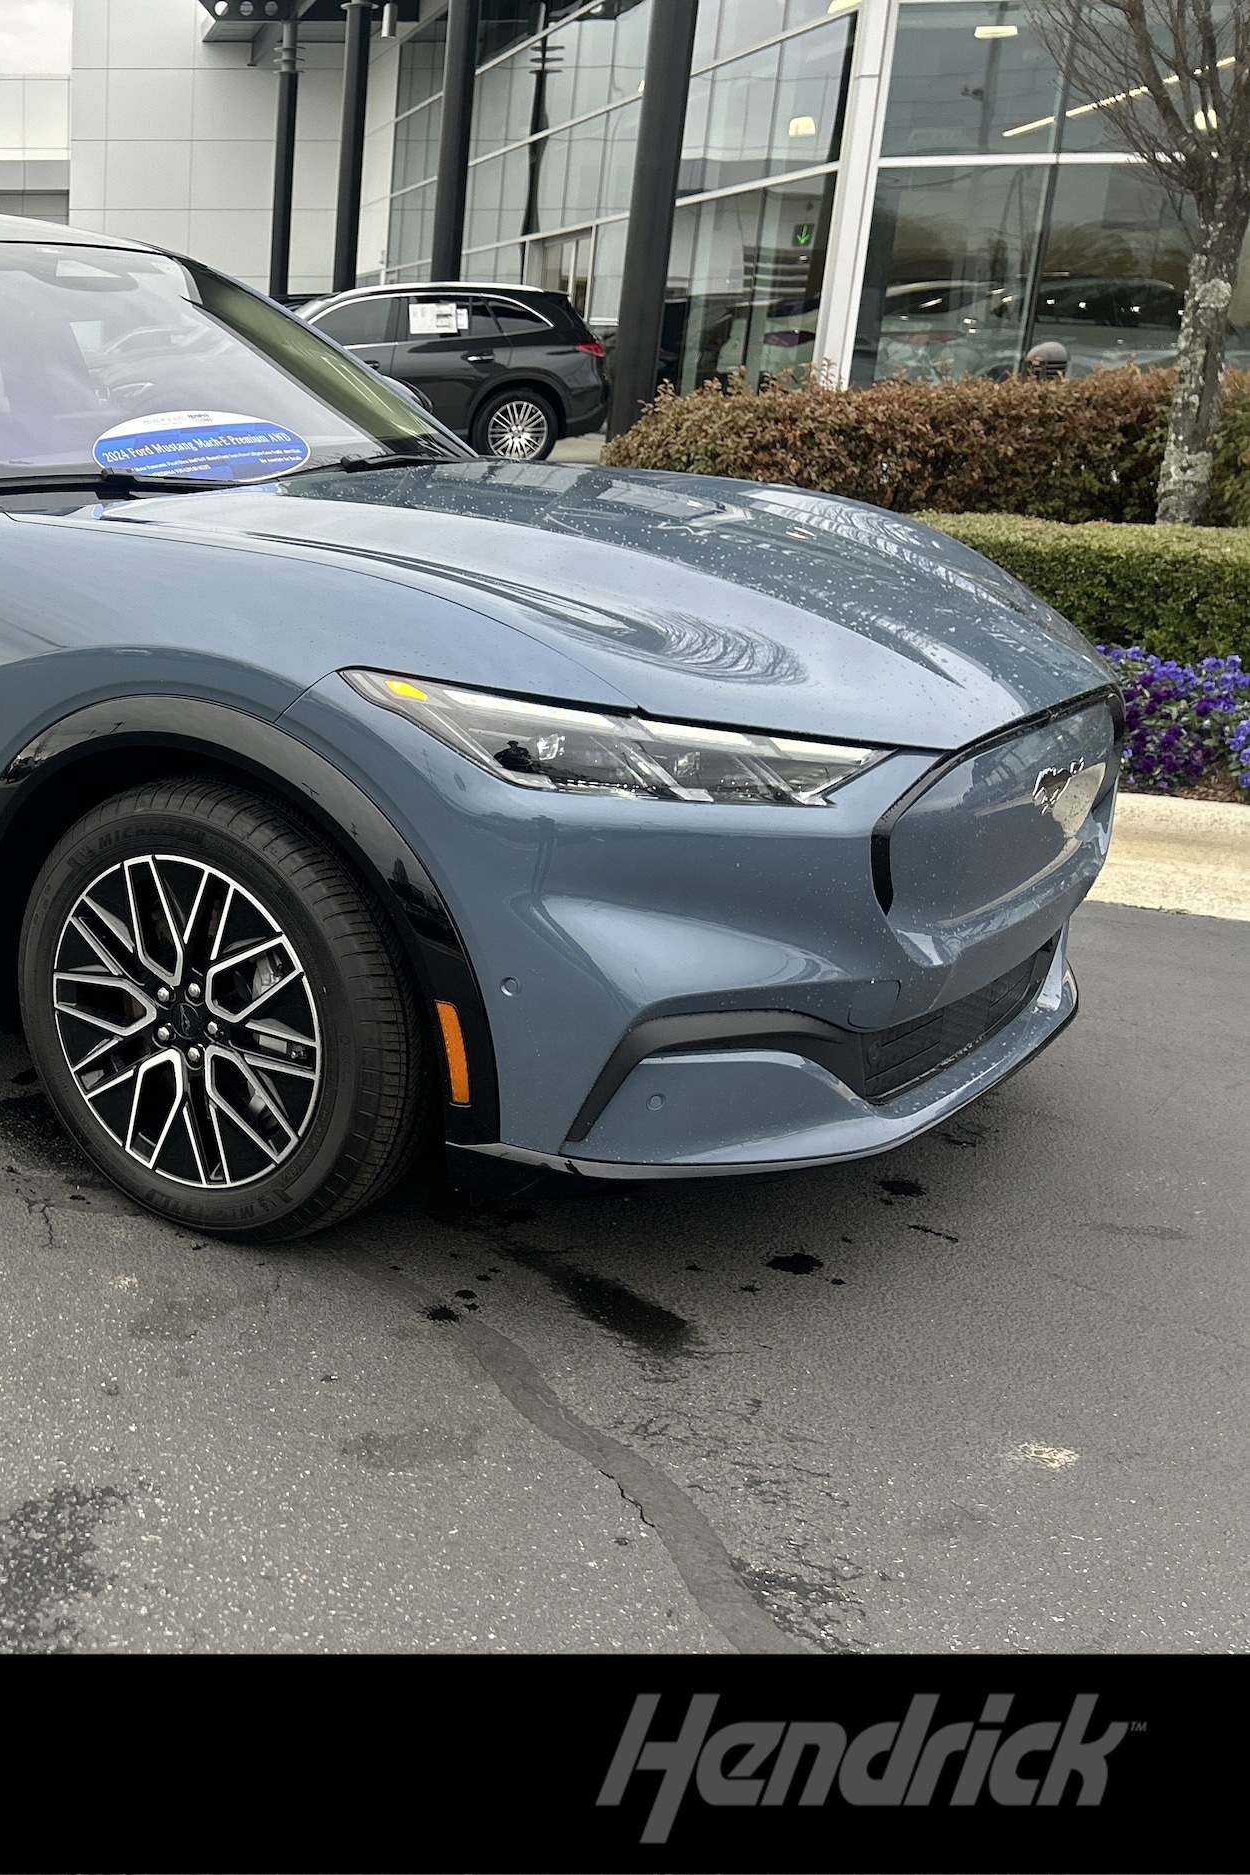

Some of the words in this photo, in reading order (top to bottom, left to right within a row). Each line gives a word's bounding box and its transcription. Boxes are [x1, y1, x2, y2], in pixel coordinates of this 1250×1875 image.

[102, 448, 130, 463] 2024
[127, 445, 155, 458] Ford
[151, 440, 198, 454] Mustang
[196, 436, 230, 449] Mach-E
[227, 433, 270, 445] Premium
[268, 432, 292, 442] AWD
